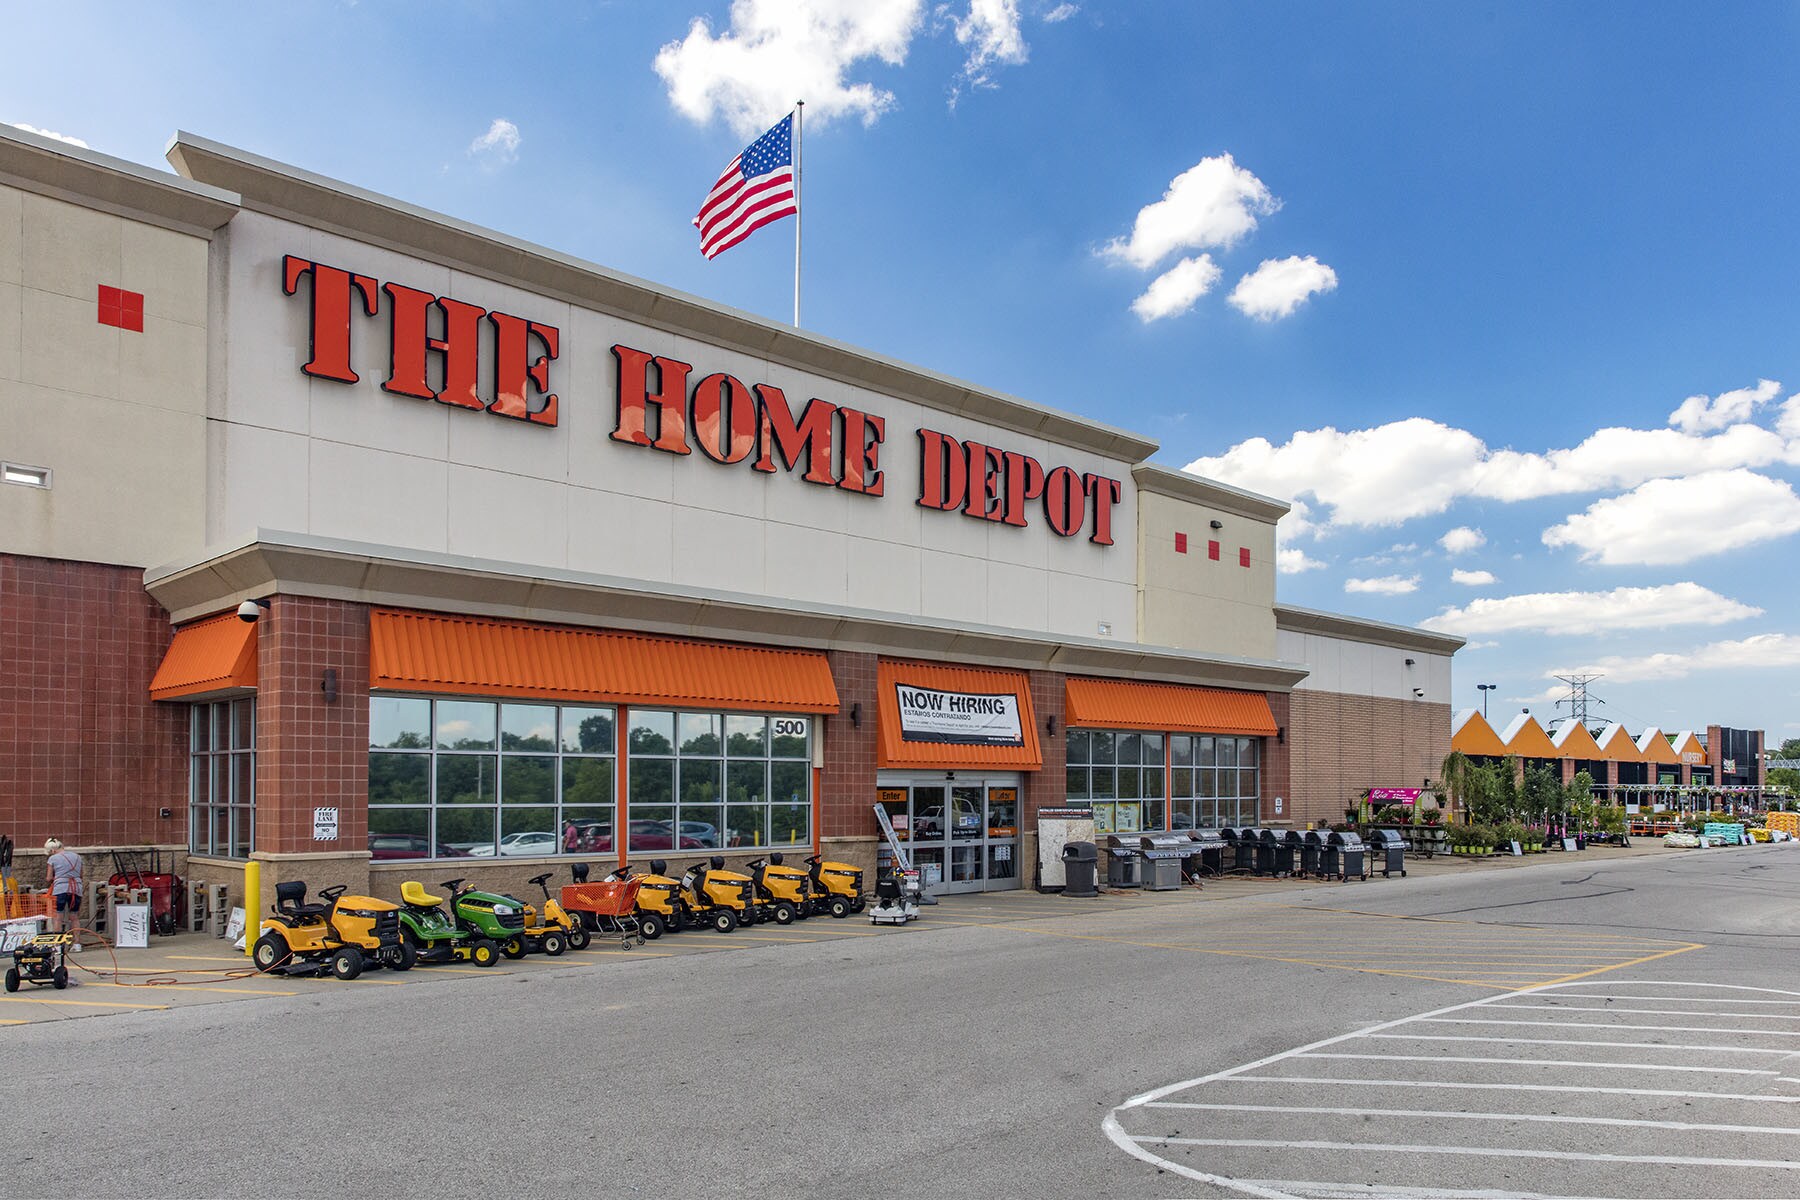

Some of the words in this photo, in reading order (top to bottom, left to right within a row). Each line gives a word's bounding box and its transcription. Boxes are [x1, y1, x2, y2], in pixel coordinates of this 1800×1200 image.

[282, 254, 560, 428] THE
[609, 343, 885, 497] HOME
[915, 427, 1121, 546] DEPOT
[902, 690, 944, 711] NOW
[949, 695, 1005, 715] HIRING
[904, 709, 931, 718] ESTAMOS
[932, 711, 971, 721] CONTRATANDO
[775, 720, 805, 735] 500
[882, 791, 901, 800] Enter
